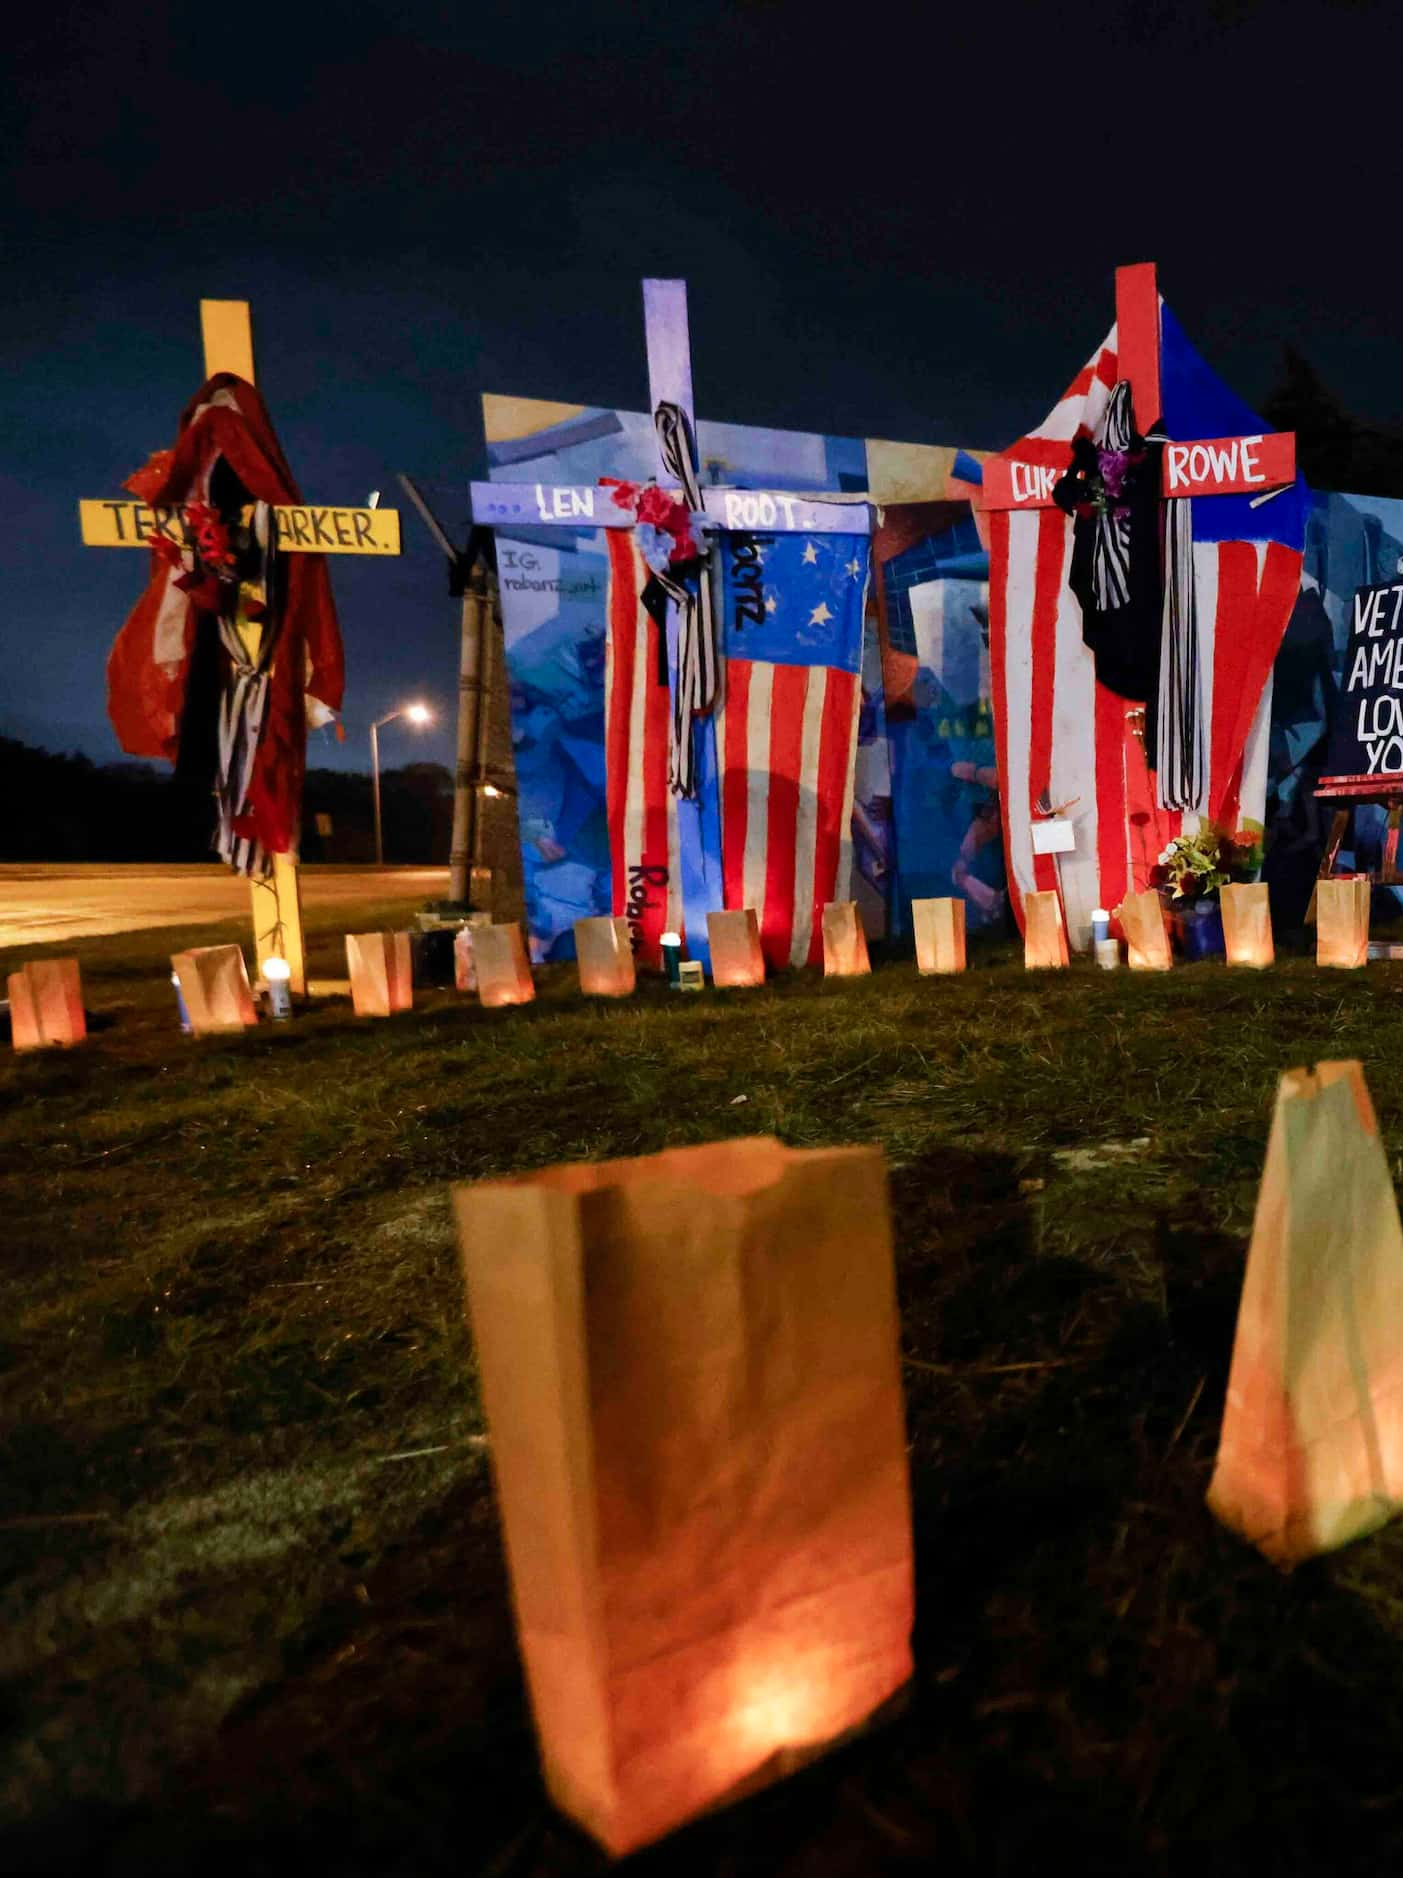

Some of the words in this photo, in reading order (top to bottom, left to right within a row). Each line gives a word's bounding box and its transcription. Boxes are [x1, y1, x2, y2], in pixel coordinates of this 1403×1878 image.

[1168, 435, 1266, 489] ROWE
[277, 508, 390, 549] ARKER.
[535, 484, 595, 521] LEN
[724, 492, 816, 530] ROOT.
